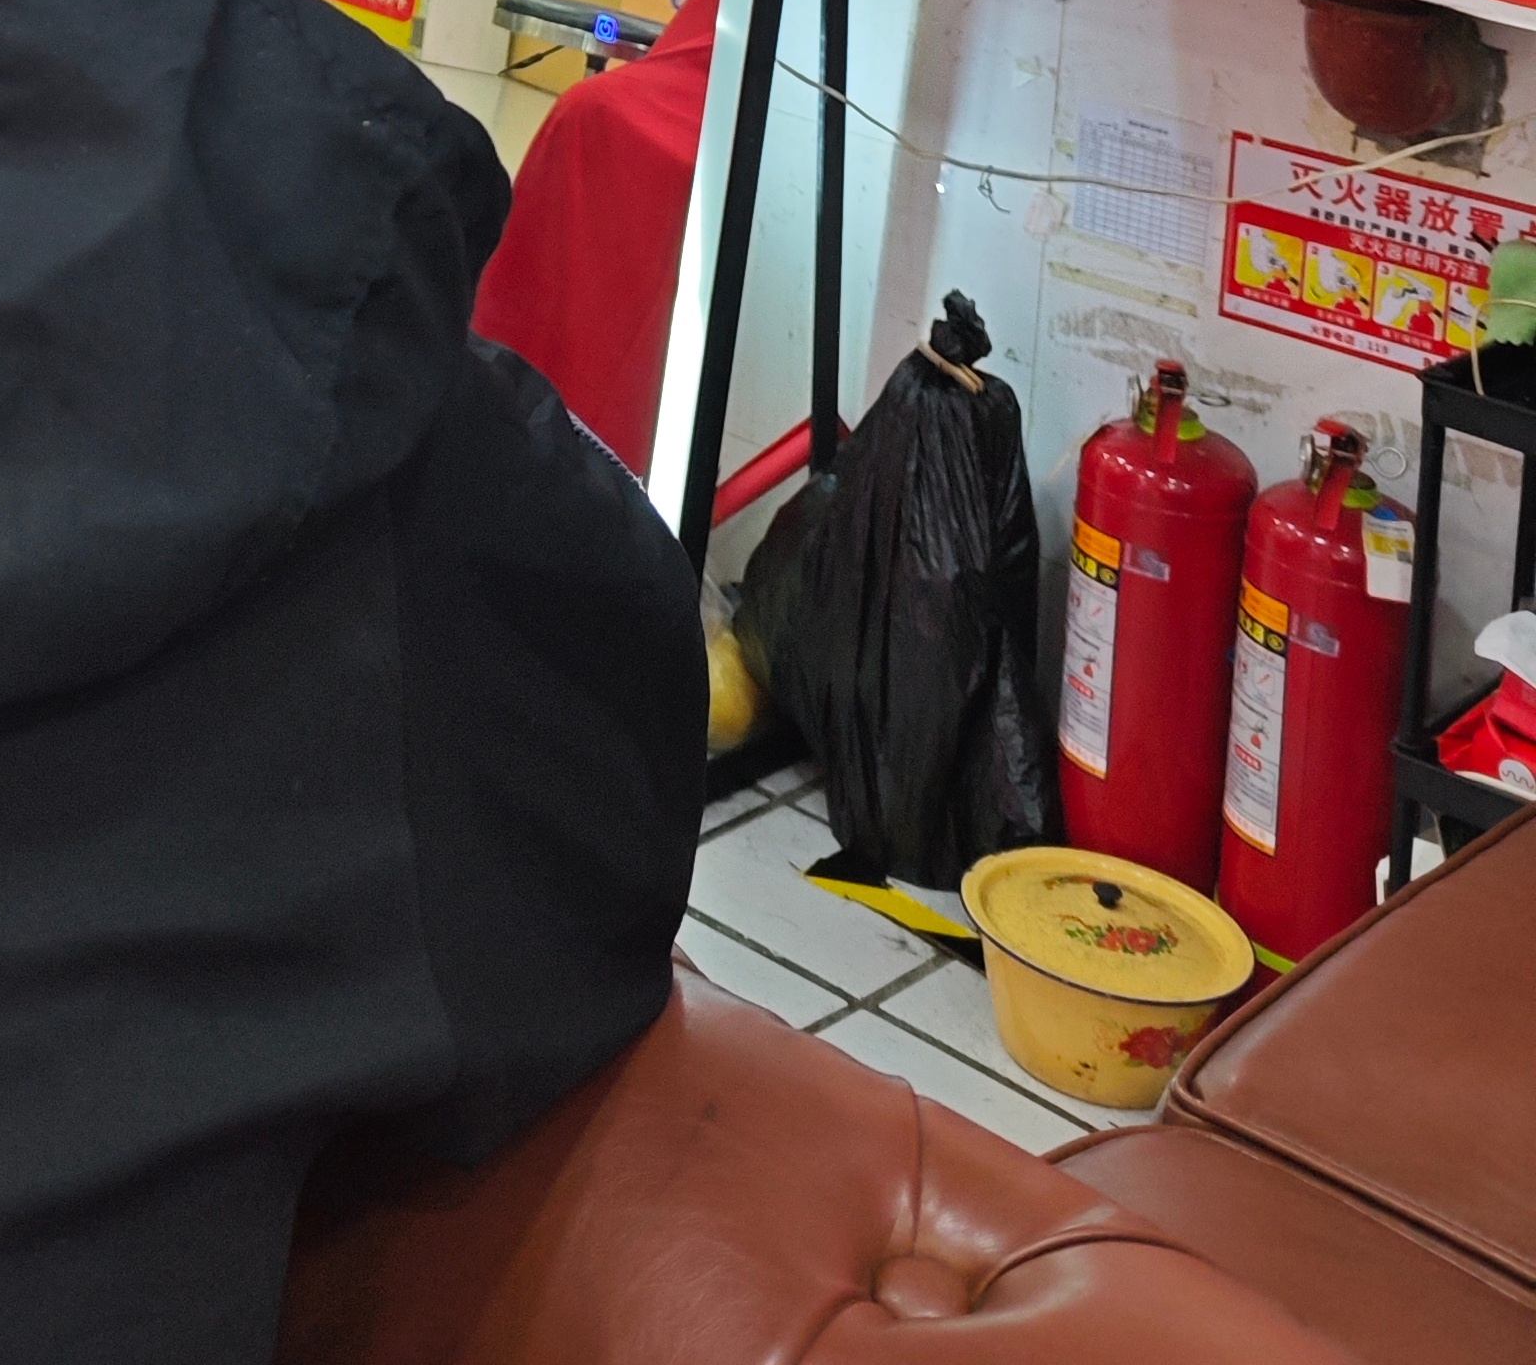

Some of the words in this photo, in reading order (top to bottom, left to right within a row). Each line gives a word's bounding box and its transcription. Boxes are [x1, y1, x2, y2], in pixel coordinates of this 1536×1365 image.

[1288, 160, 1536, 244] 灭火器放置
